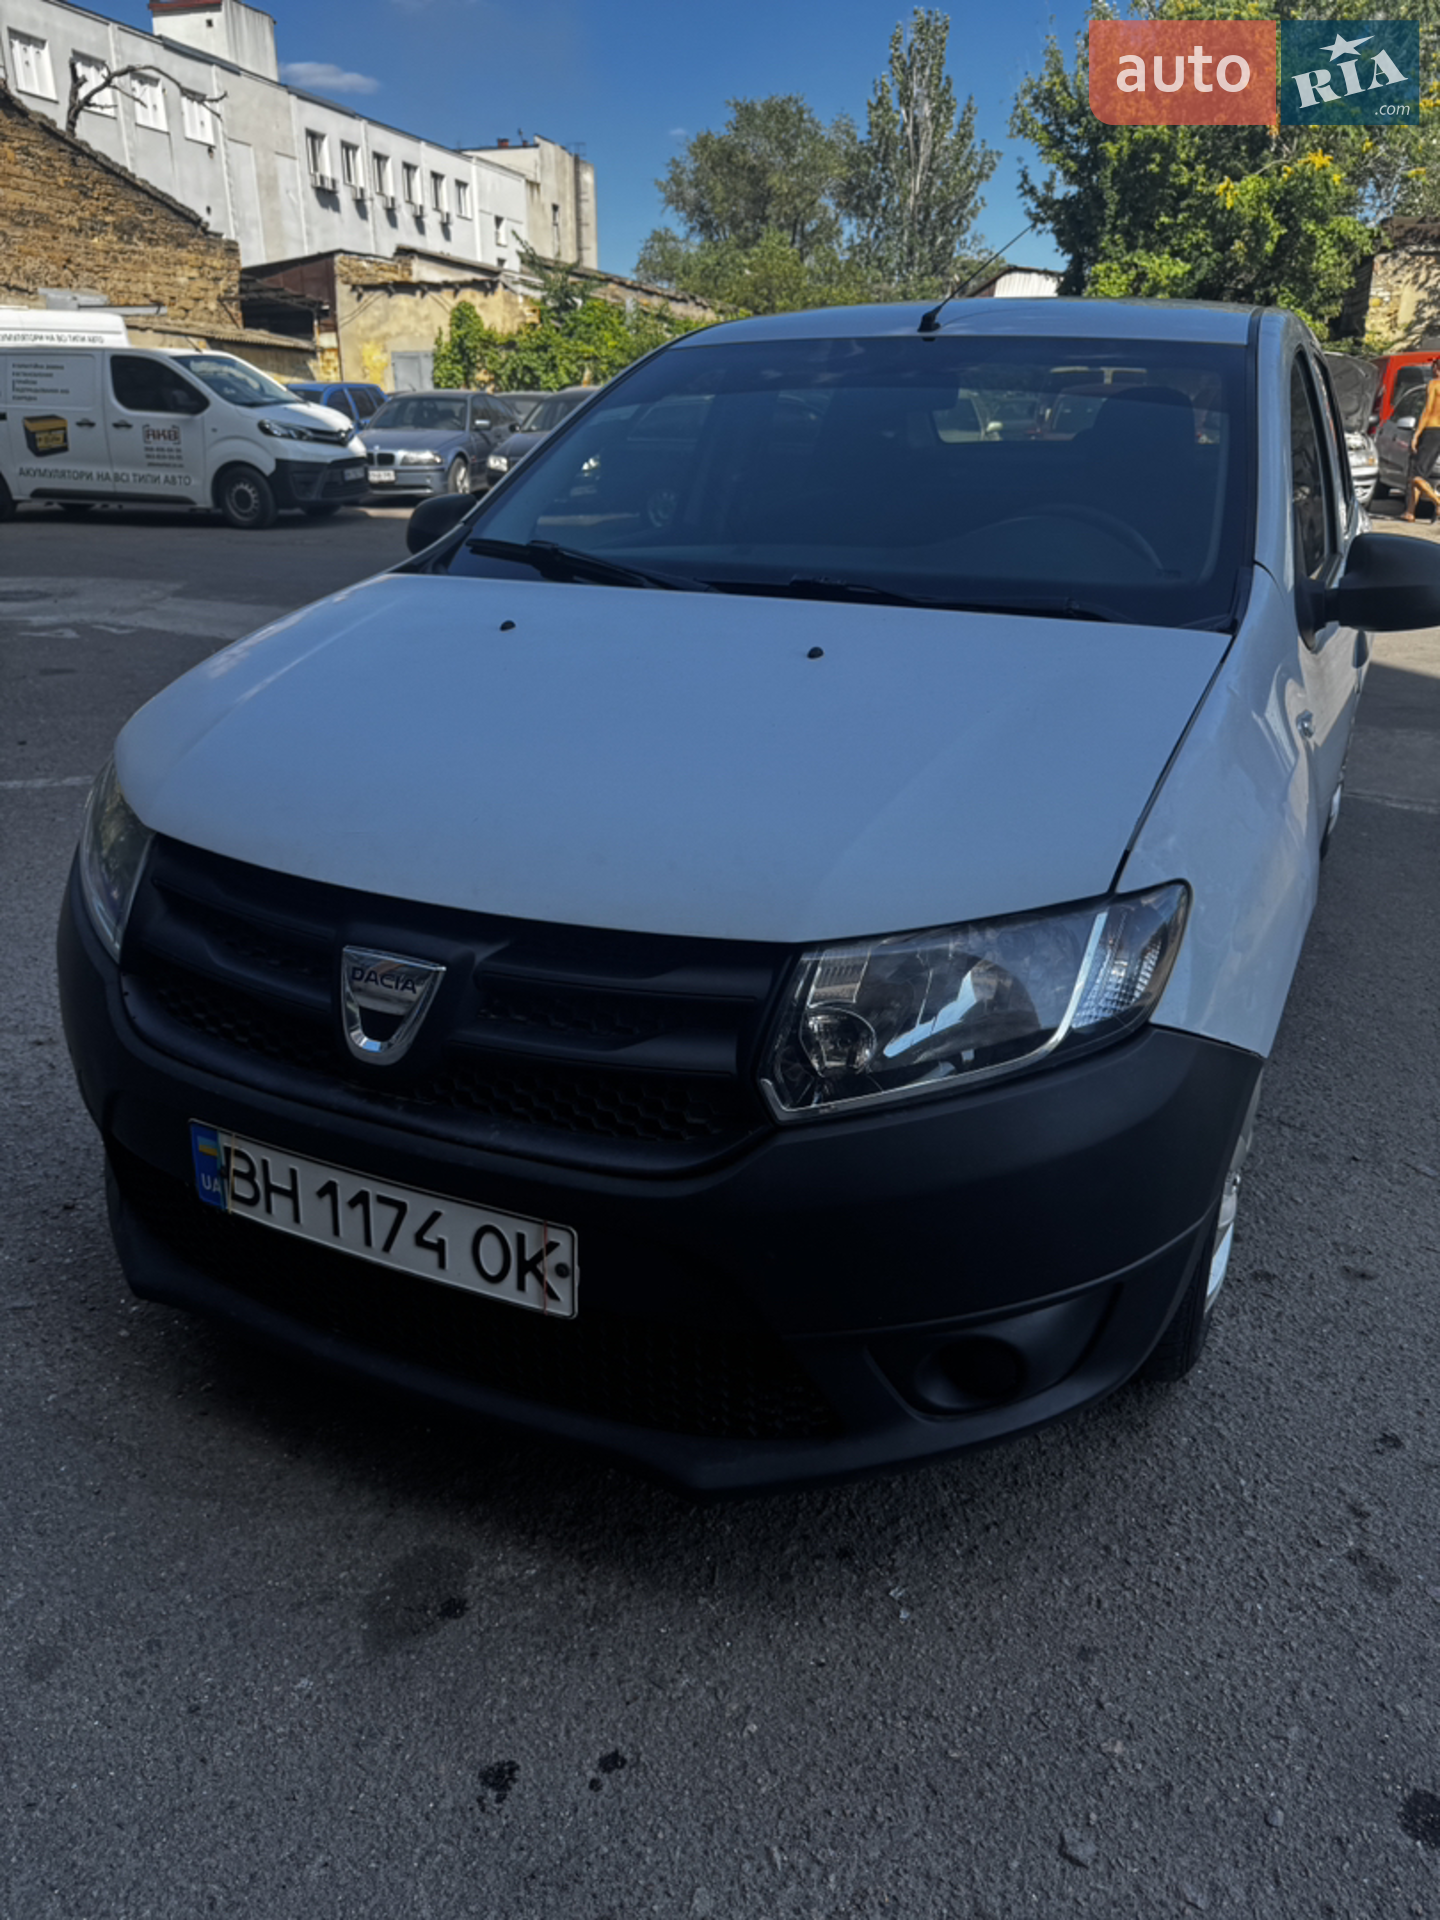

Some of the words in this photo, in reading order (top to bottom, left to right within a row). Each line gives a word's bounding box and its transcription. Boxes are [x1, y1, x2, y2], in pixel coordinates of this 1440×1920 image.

[19, 467, 93, 481] АКУМУЛЯТОРИ
[96, 470, 112, 482] НА
[132, 473, 161, 485] ТИПИ
[163, 475, 192, 486] АВТО
[351, 966, 417, 995] DACIA
[201, 1172, 221, 1194] UA
[223, 1145, 302, 1224] BH
[316, 1179, 447, 1270] 1174
[471, 1223, 562, 1301] OK
